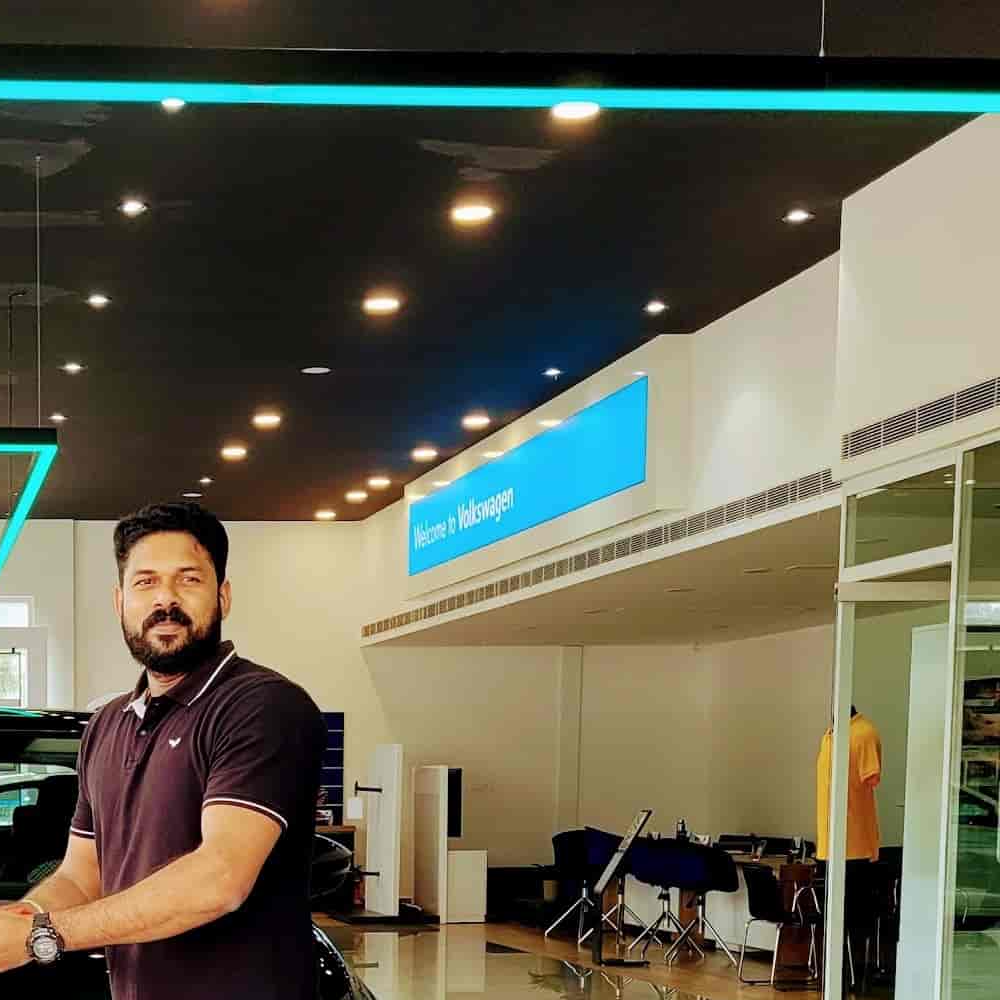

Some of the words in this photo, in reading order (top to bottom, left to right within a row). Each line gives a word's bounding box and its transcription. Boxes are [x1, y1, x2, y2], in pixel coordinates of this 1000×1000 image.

[413, 520, 447, 550] Welcome
[448, 512, 456, 535] to
[457, 487, 514, 532] Volkswagen
